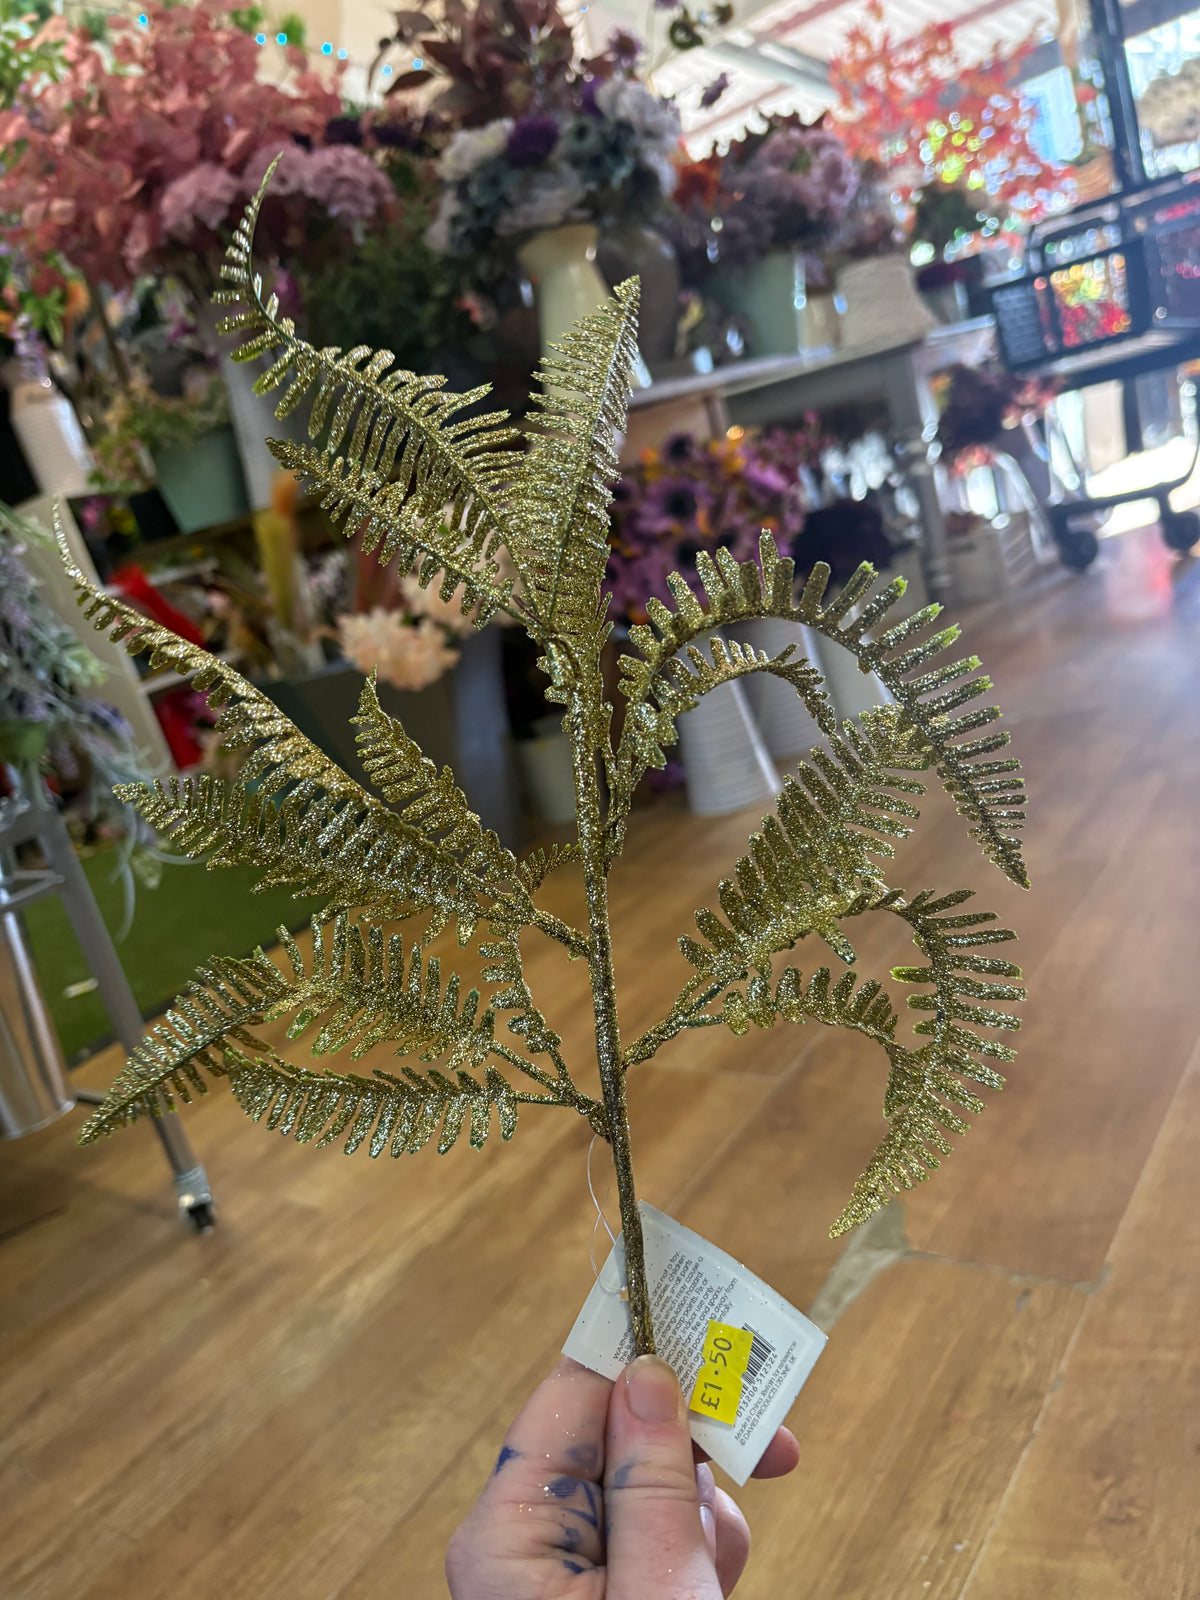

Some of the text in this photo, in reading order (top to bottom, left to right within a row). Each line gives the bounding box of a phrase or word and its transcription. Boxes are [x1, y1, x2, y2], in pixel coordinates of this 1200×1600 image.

[659, 1268, 669, 1282] not
[653, 1312, 661, 1321] to
[679, 1259, 692, 1277] parts
[675, 1282, 687, 1298] may
[698, 1304, 710, 1321] and
[658, 1335, 674, 1357] ontain
[734, 1421, 748, 1440] Made
